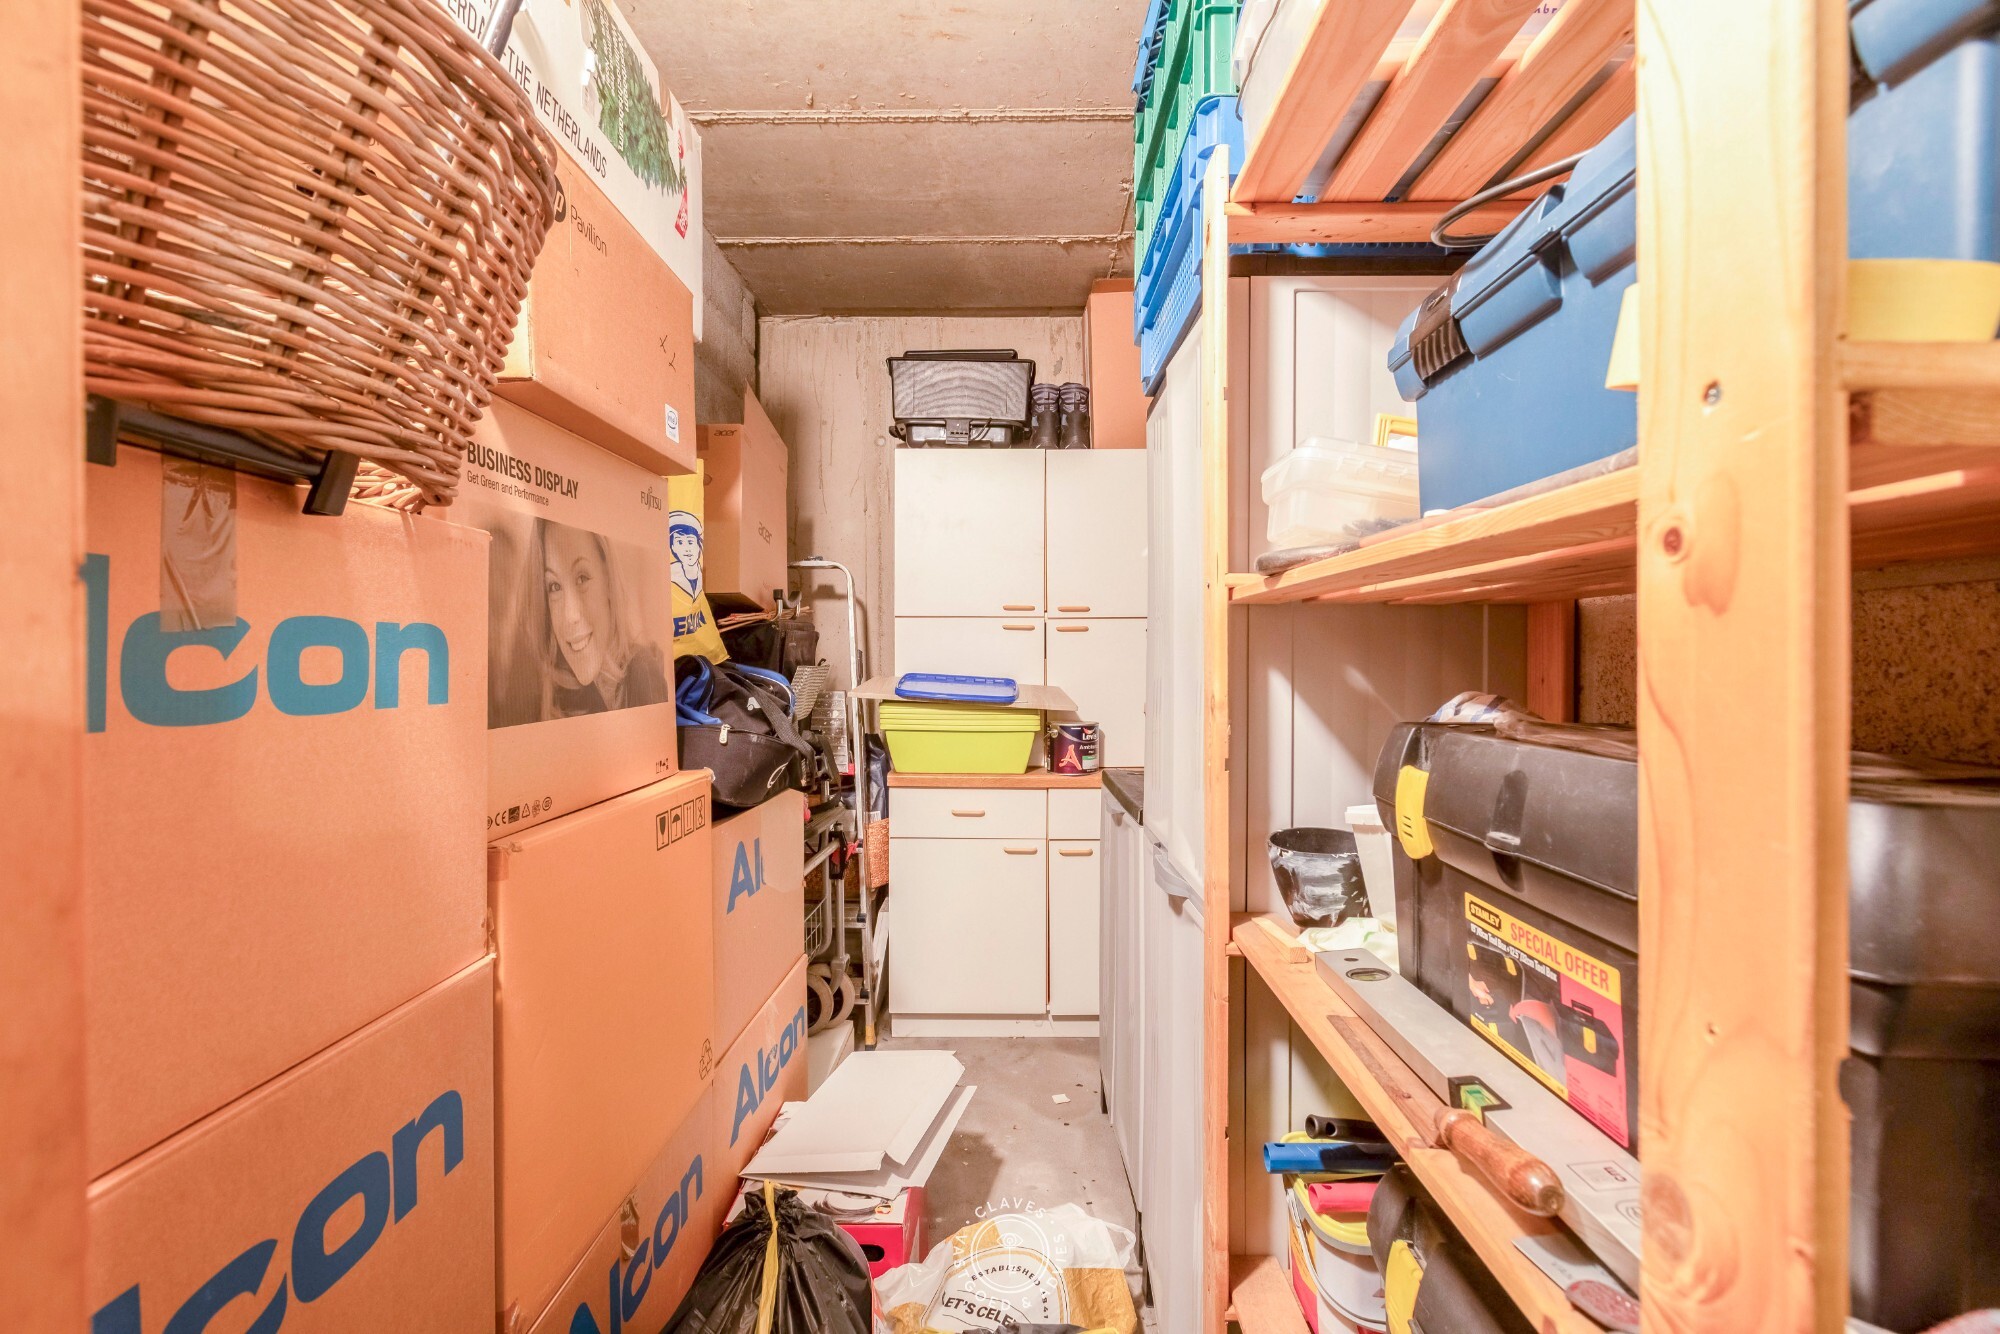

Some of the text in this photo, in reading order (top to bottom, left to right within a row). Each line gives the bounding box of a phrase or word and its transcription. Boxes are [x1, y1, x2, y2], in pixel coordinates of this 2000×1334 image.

[508, 45, 607, 179] THE NETHERLANDS
[714, 429, 737, 437] acer
[467, 441, 579, 500] BUSINESS DISPLAY
[467, 470, 549, 506] Get Green and Performance
[640, 486, 662, 511] FUJITSU
[758, 521, 772, 545] acer
[85, 552, 450, 734] lcon
[1470, 903, 1501, 928] STANLEY
[1510, 922, 1610, 992] SPECIAL OFFER
[730, 1005, 805, 1148] Alcon
[971, 1265, 1041, 1286] ESTABLISHED
[976, 1306, 1017, 1328] CELE
